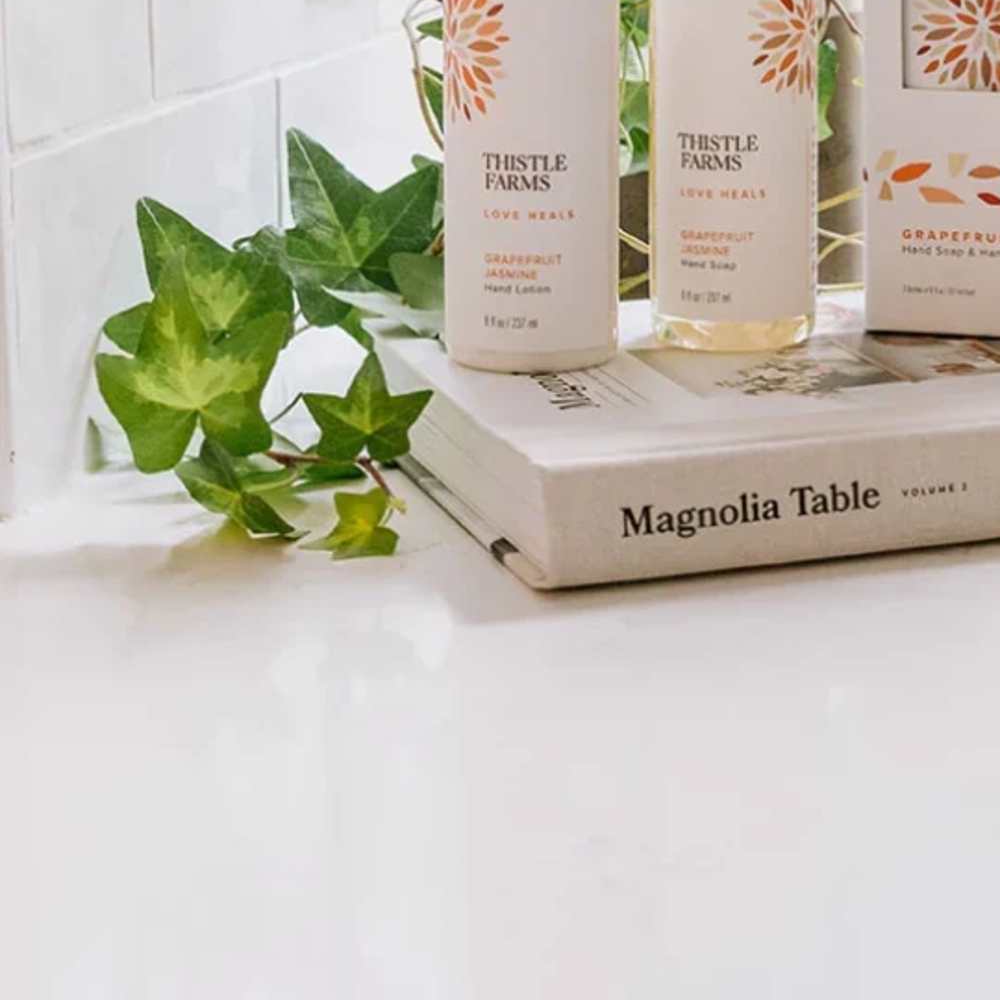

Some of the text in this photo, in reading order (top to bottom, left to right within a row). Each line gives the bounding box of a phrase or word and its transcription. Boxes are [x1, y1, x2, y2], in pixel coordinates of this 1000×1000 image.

[677, 132, 759, 152] THISTLE
[482, 152, 568, 172] THISTLE
[681, 152, 742, 171] FARMS
[485, 173, 551, 191] FARMS
[680, 188, 766, 200] LOVE HEALS
[484, 210, 574, 221] LOVE HEALS
[902, 246, 931, 256] Hand
[620, 493, 781, 538] Magnolia
[790, 481, 881, 517] Table
[902, 484, 955, 497] VOLUME
